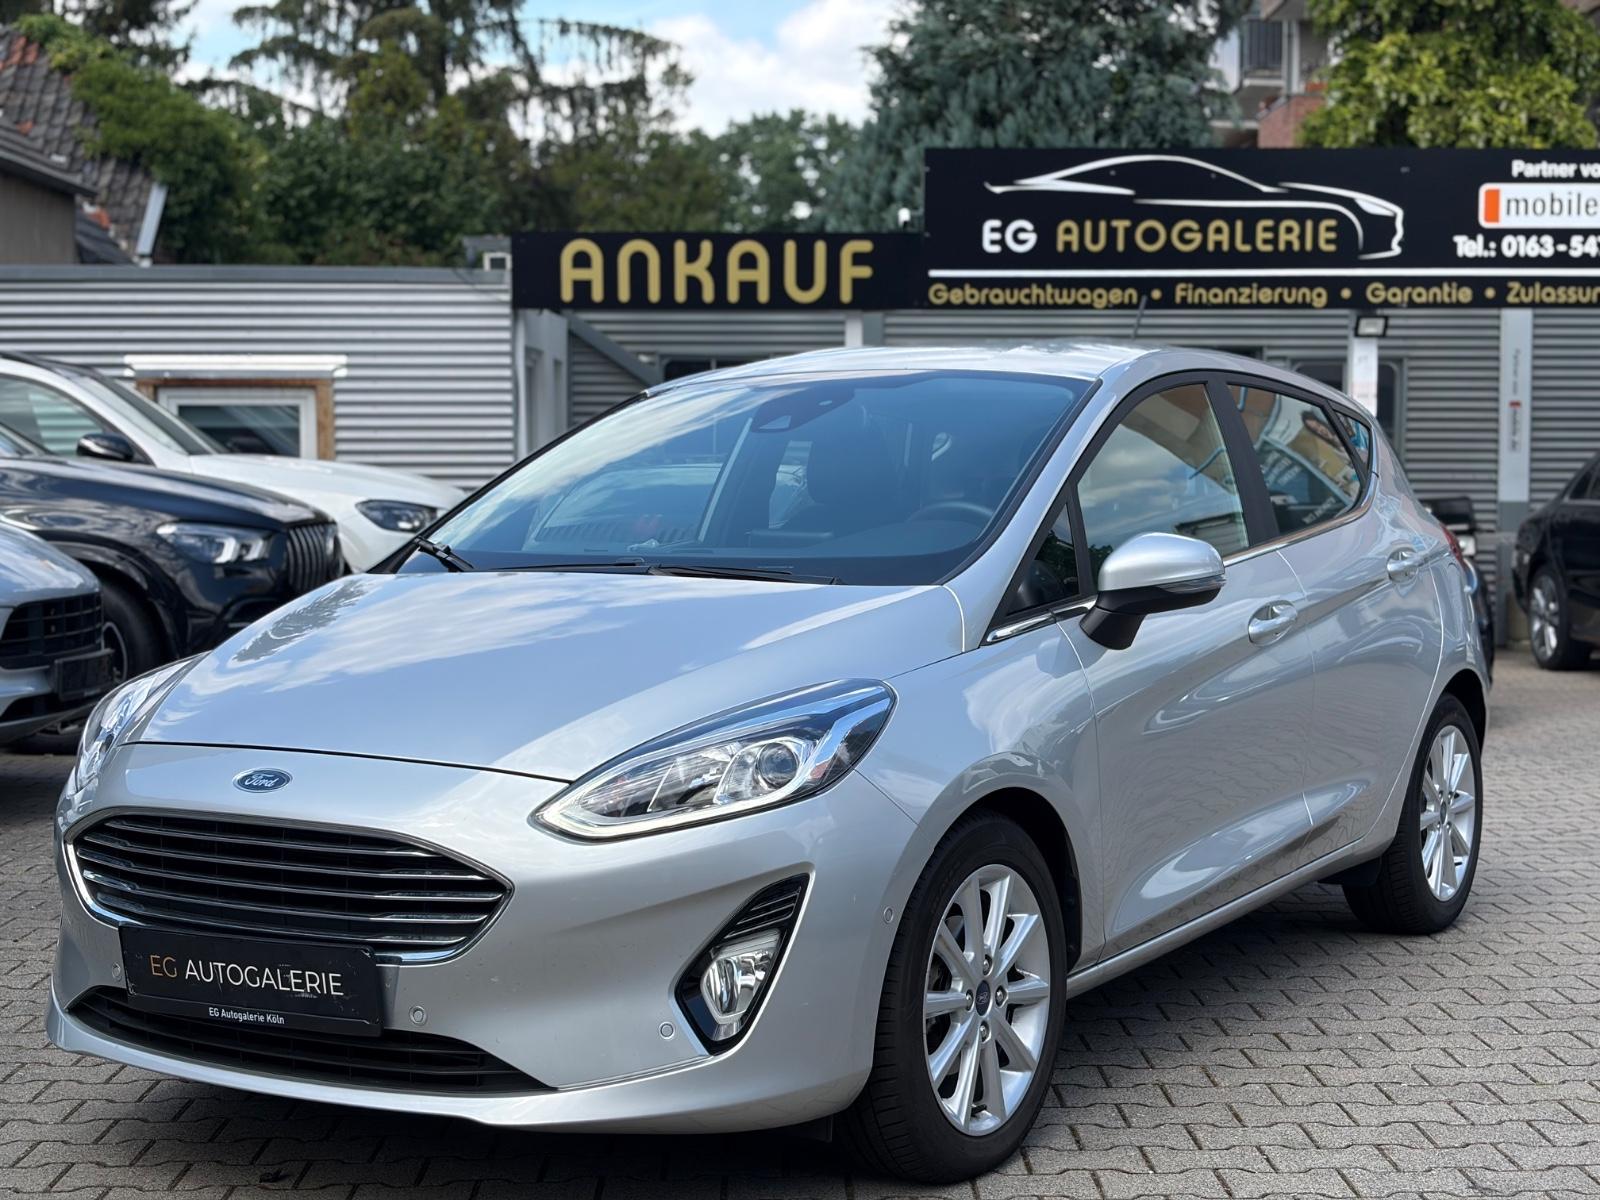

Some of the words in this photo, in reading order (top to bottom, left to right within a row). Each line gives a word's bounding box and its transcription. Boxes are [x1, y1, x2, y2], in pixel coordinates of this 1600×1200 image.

[1511, 159, 1577, 178] Partner
[1506, 191, 1598, 217] mobile
[982, 219, 1037, 253] EG
[1056, 219, 1338, 252] AUTOGALERIE
[1453, 234, 1496, 258] Tel.:
[560, 239, 874, 304] ANKAUF
[928, 283, 1138, 309] Gebrauchtwagen
[1175, 282, 1328, 308] Finanzierung
[1366, 282, 1473, 304] Garantie
[244, 773, 280, 788] Ford
[150, 955, 178, 978] EG
[185, 959, 344, 996] AUTOGALERIE
[208, 1007, 220, 1017] EG
[220, 1008, 265, 1022] Autogalerie
[266, 1013, 285, 1025] Köln
